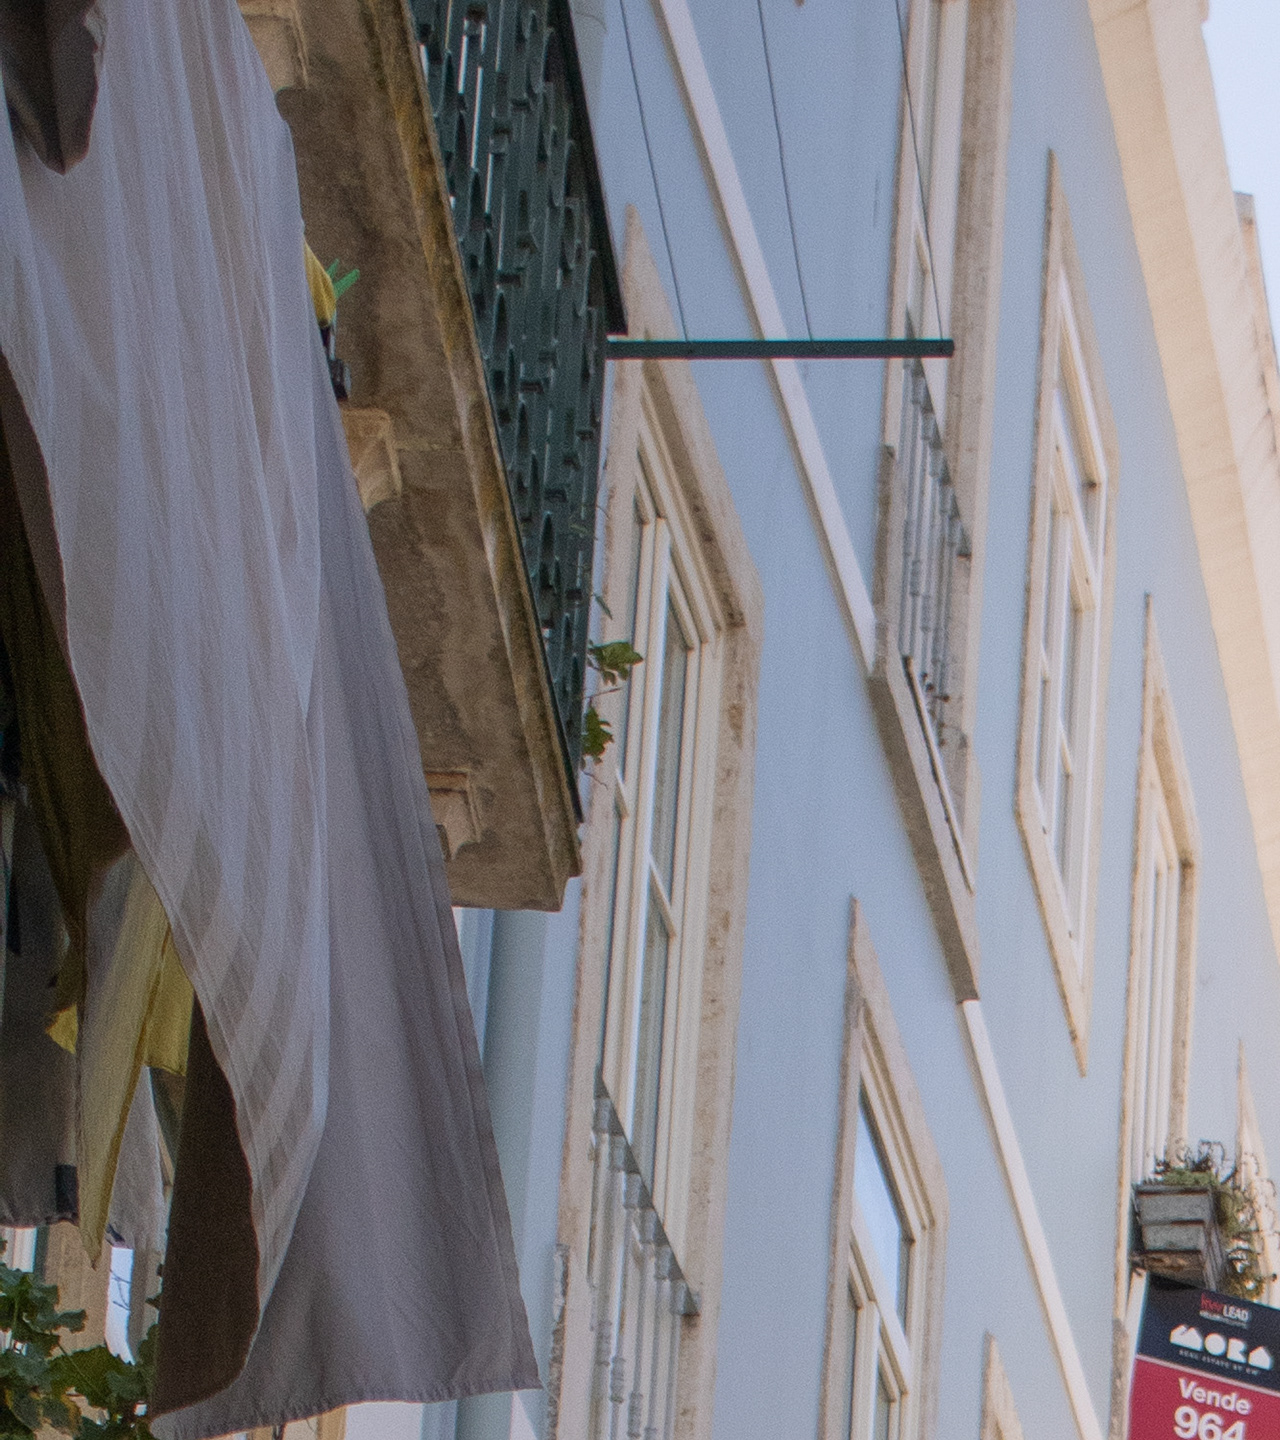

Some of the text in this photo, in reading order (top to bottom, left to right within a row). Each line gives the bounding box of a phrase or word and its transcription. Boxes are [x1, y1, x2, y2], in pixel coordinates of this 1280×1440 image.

[1222, 1303, 1250, 1323] LEAD
[1169, 1325, 1274, 1371] MORA
[1178, 1377, 1251, 1416] Vende
